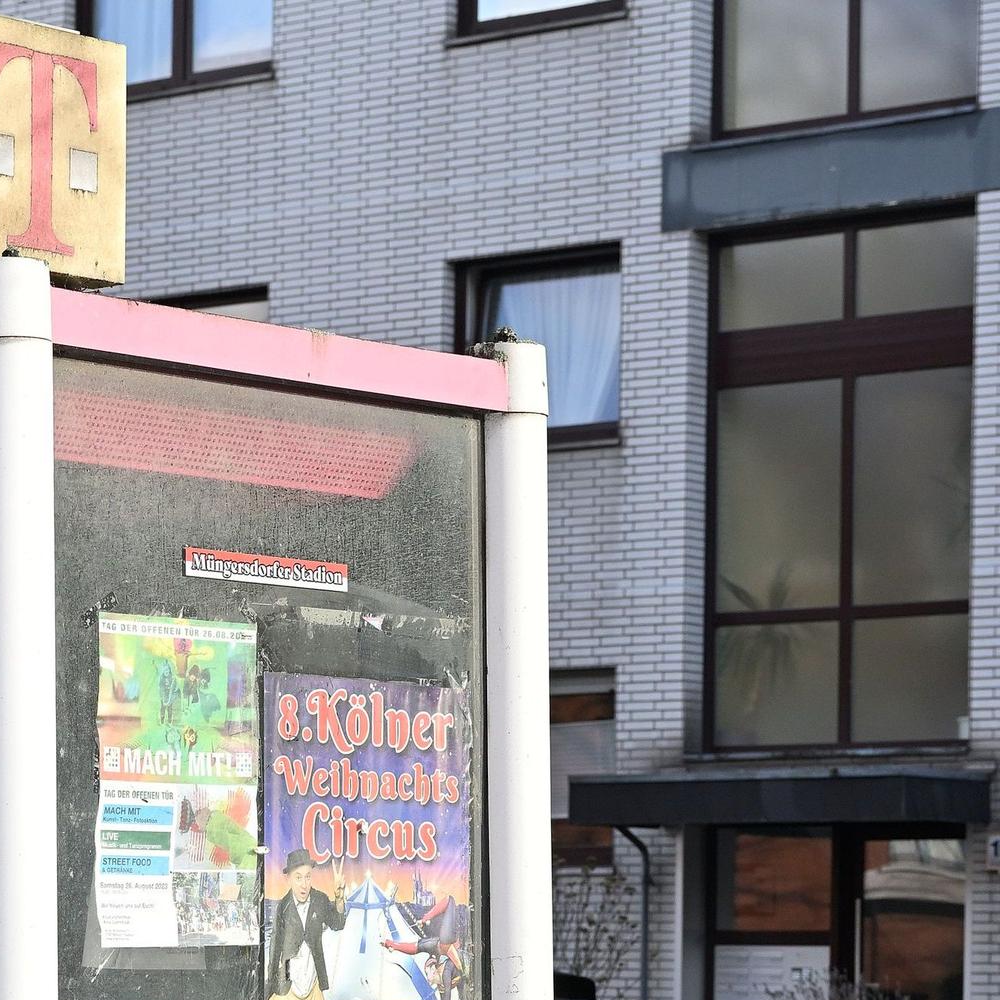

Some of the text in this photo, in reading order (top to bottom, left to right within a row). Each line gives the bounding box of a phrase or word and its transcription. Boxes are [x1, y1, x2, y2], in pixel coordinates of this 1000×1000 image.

[191, 551, 343, 585] Müngersdorfer Stadion
[102, 621, 117, 631] TAG
[120, 623, 138, 633] DER
[141, 623, 181, 636] OFFENEN
[184, 626, 199, 638] TÜR
[123, 747, 233, 777] MACH MIT!
[274, 755, 459, 805] Weihnachts
[103, 789, 173, 800] TAG DER OFFENEN TÜR
[103, 806, 141, 815] MACH MIT
[102, 832, 119, 841] LIVE
[302, 802, 437, 865] Circus
[102, 857, 152, 867] STREET FOOD
